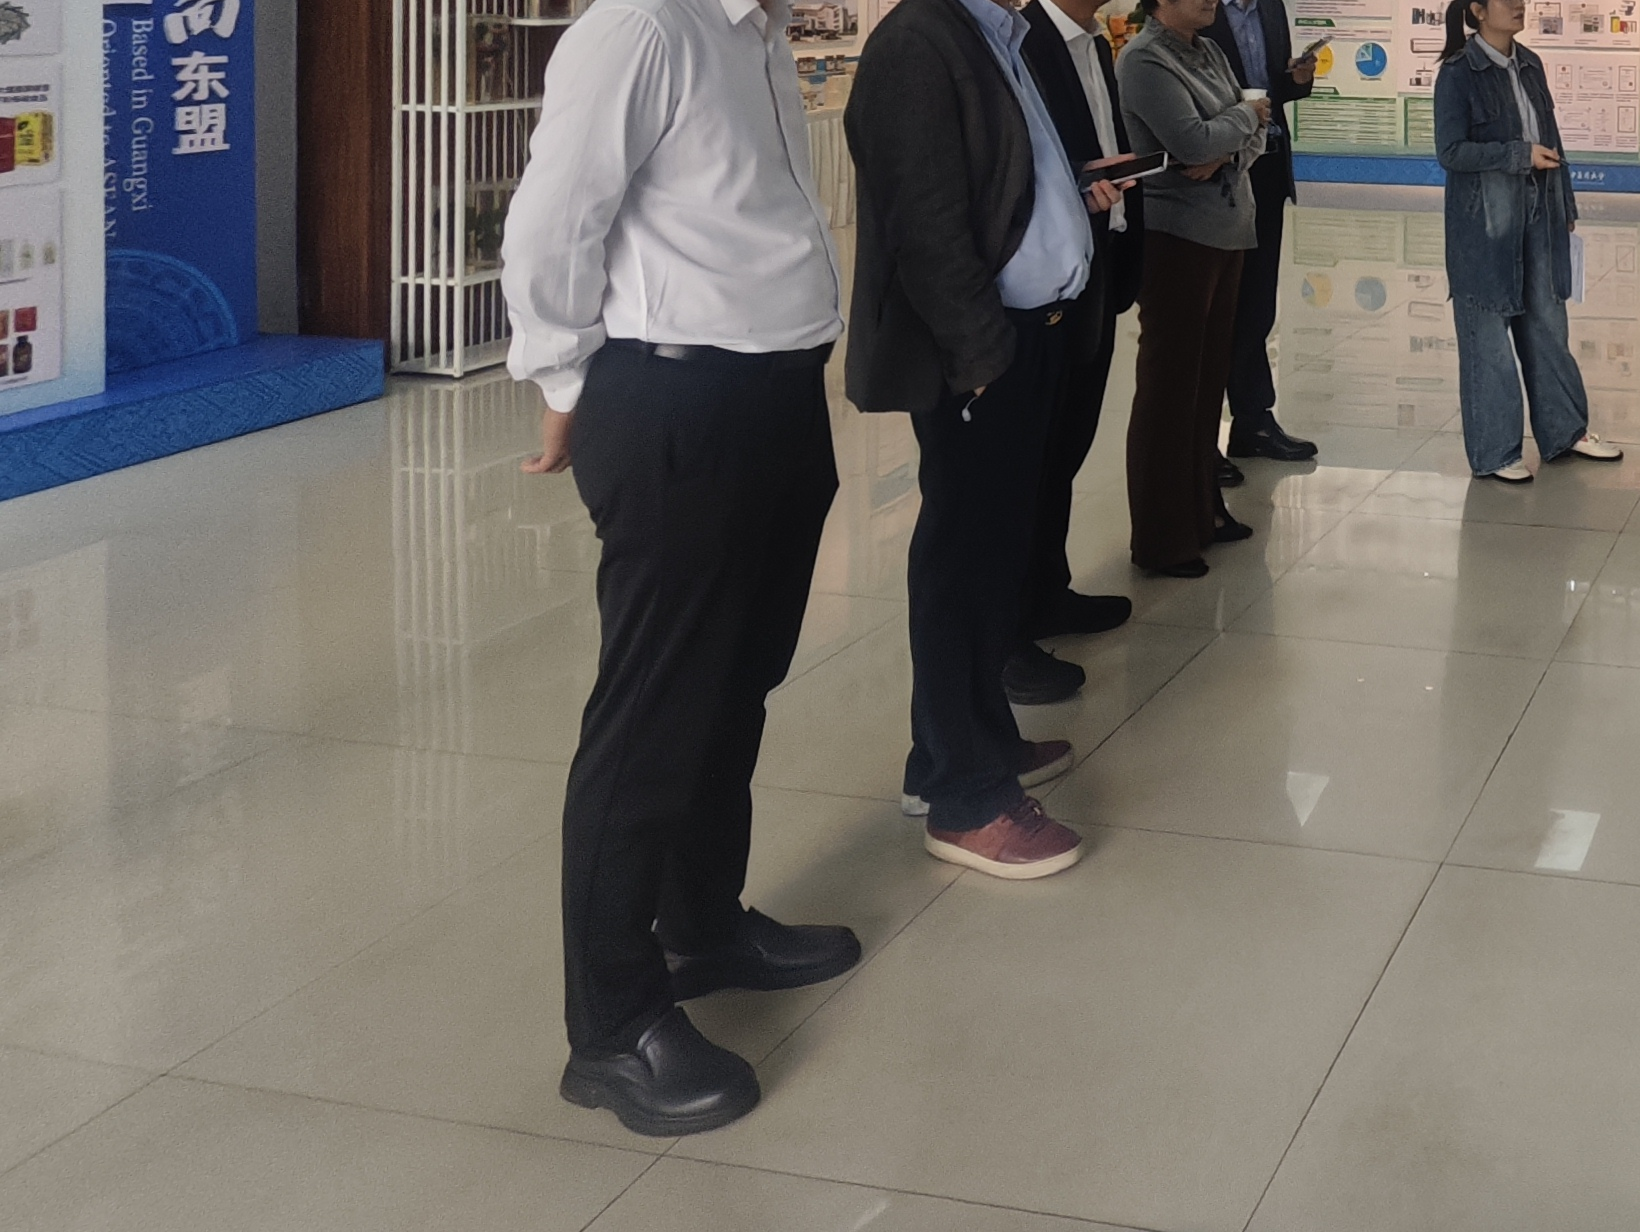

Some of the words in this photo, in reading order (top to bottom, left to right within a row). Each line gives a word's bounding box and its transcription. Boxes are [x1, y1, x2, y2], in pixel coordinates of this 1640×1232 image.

[131, 18, 155, 82] Based
[131, 88, 154, 111] in
[122, 116, 155, 212] Guangxi
